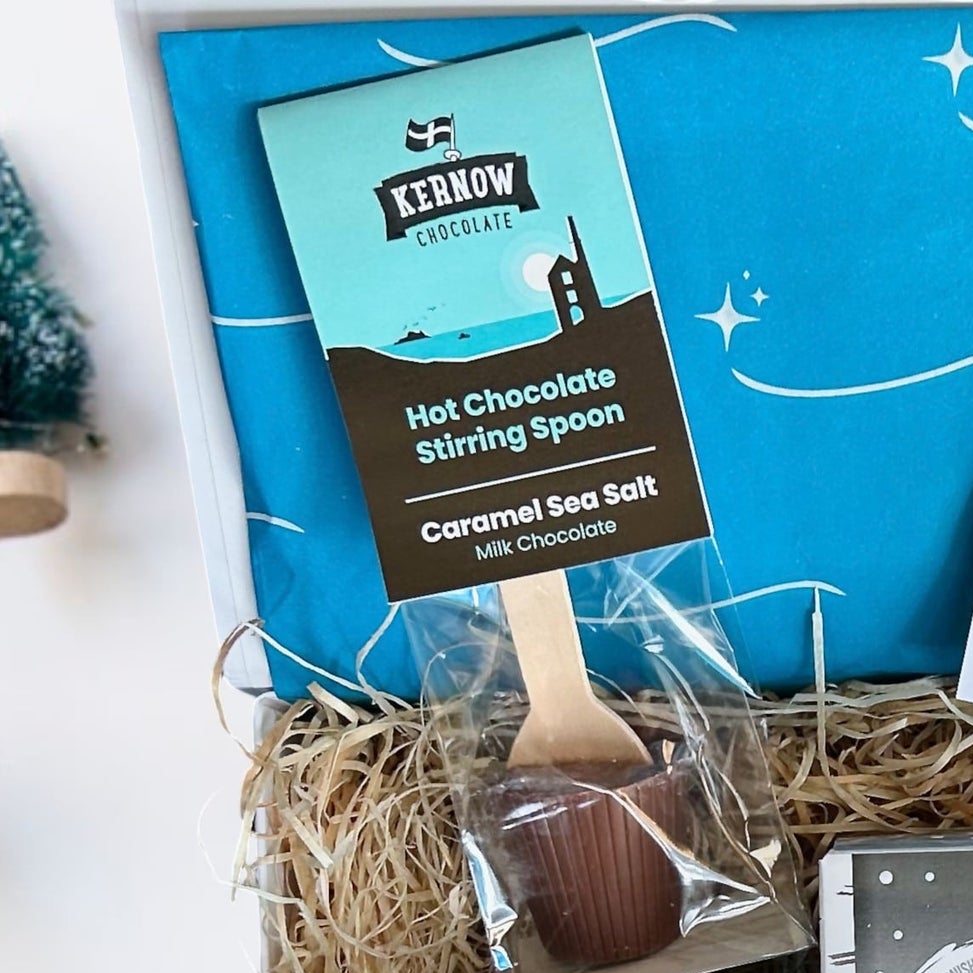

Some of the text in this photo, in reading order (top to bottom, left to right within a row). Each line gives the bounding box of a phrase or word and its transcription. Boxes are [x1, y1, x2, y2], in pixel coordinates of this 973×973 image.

[390, 162, 516, 218] KERNOW
[416, 212, 513, 247] CHOCOLATE
[406, 367, 617, 430] Hot Chocolate
[415, 402, 625, 464] Stirring Spoon
[420, 475, 659, 543] Caramel Sea Salt
[474, 519, 617, 561] Milk Chocolate
